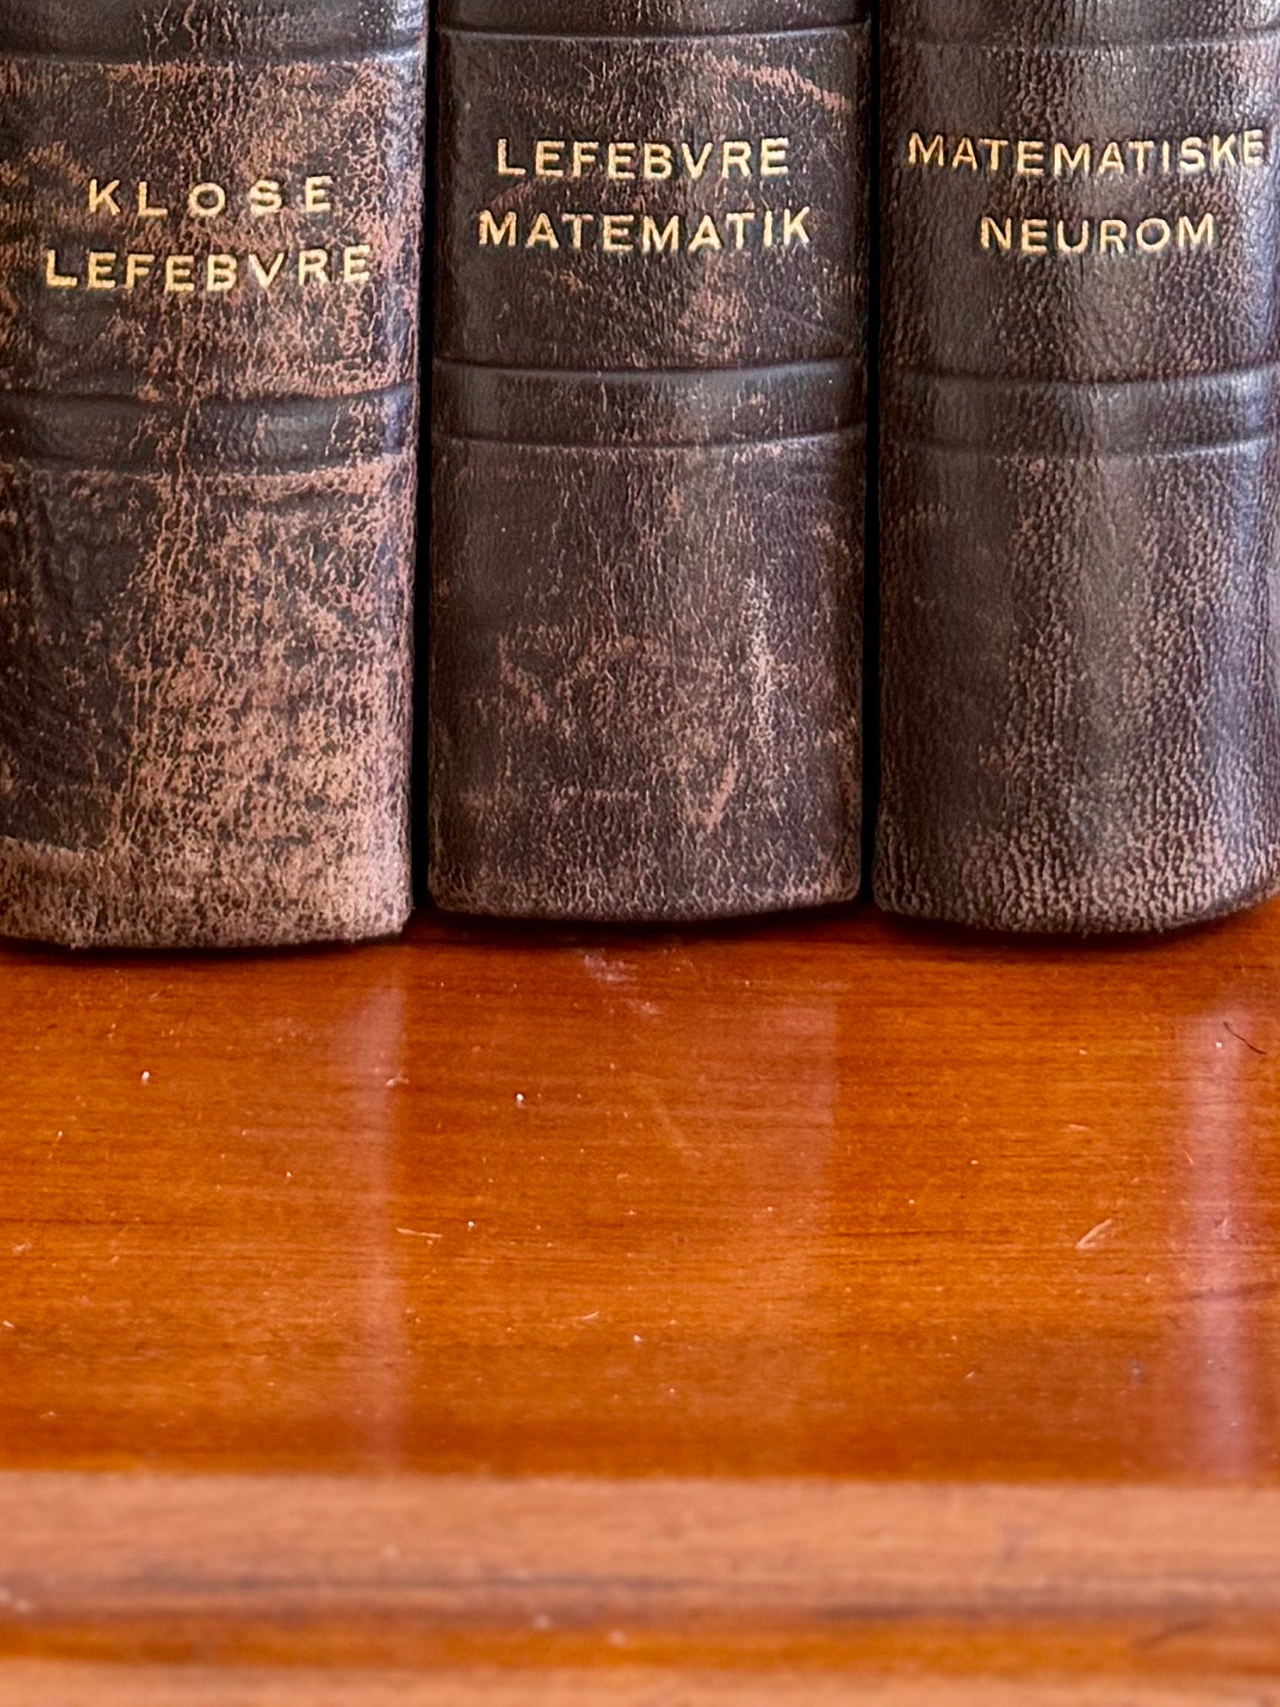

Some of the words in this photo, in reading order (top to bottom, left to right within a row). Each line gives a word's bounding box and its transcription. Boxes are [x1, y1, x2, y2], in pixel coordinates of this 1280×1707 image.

[496, 137, 791, 177] LEFEBVRE
[908, 129, 1268, 176] MATEMATISKE
[88, 177, 334, 218] KLOSE
[477, 209, 813, 250] MATEMATIK
[981, 212, 1216, 252] NEUROM
[46, 246, 372, 292] LEFEBVRE
